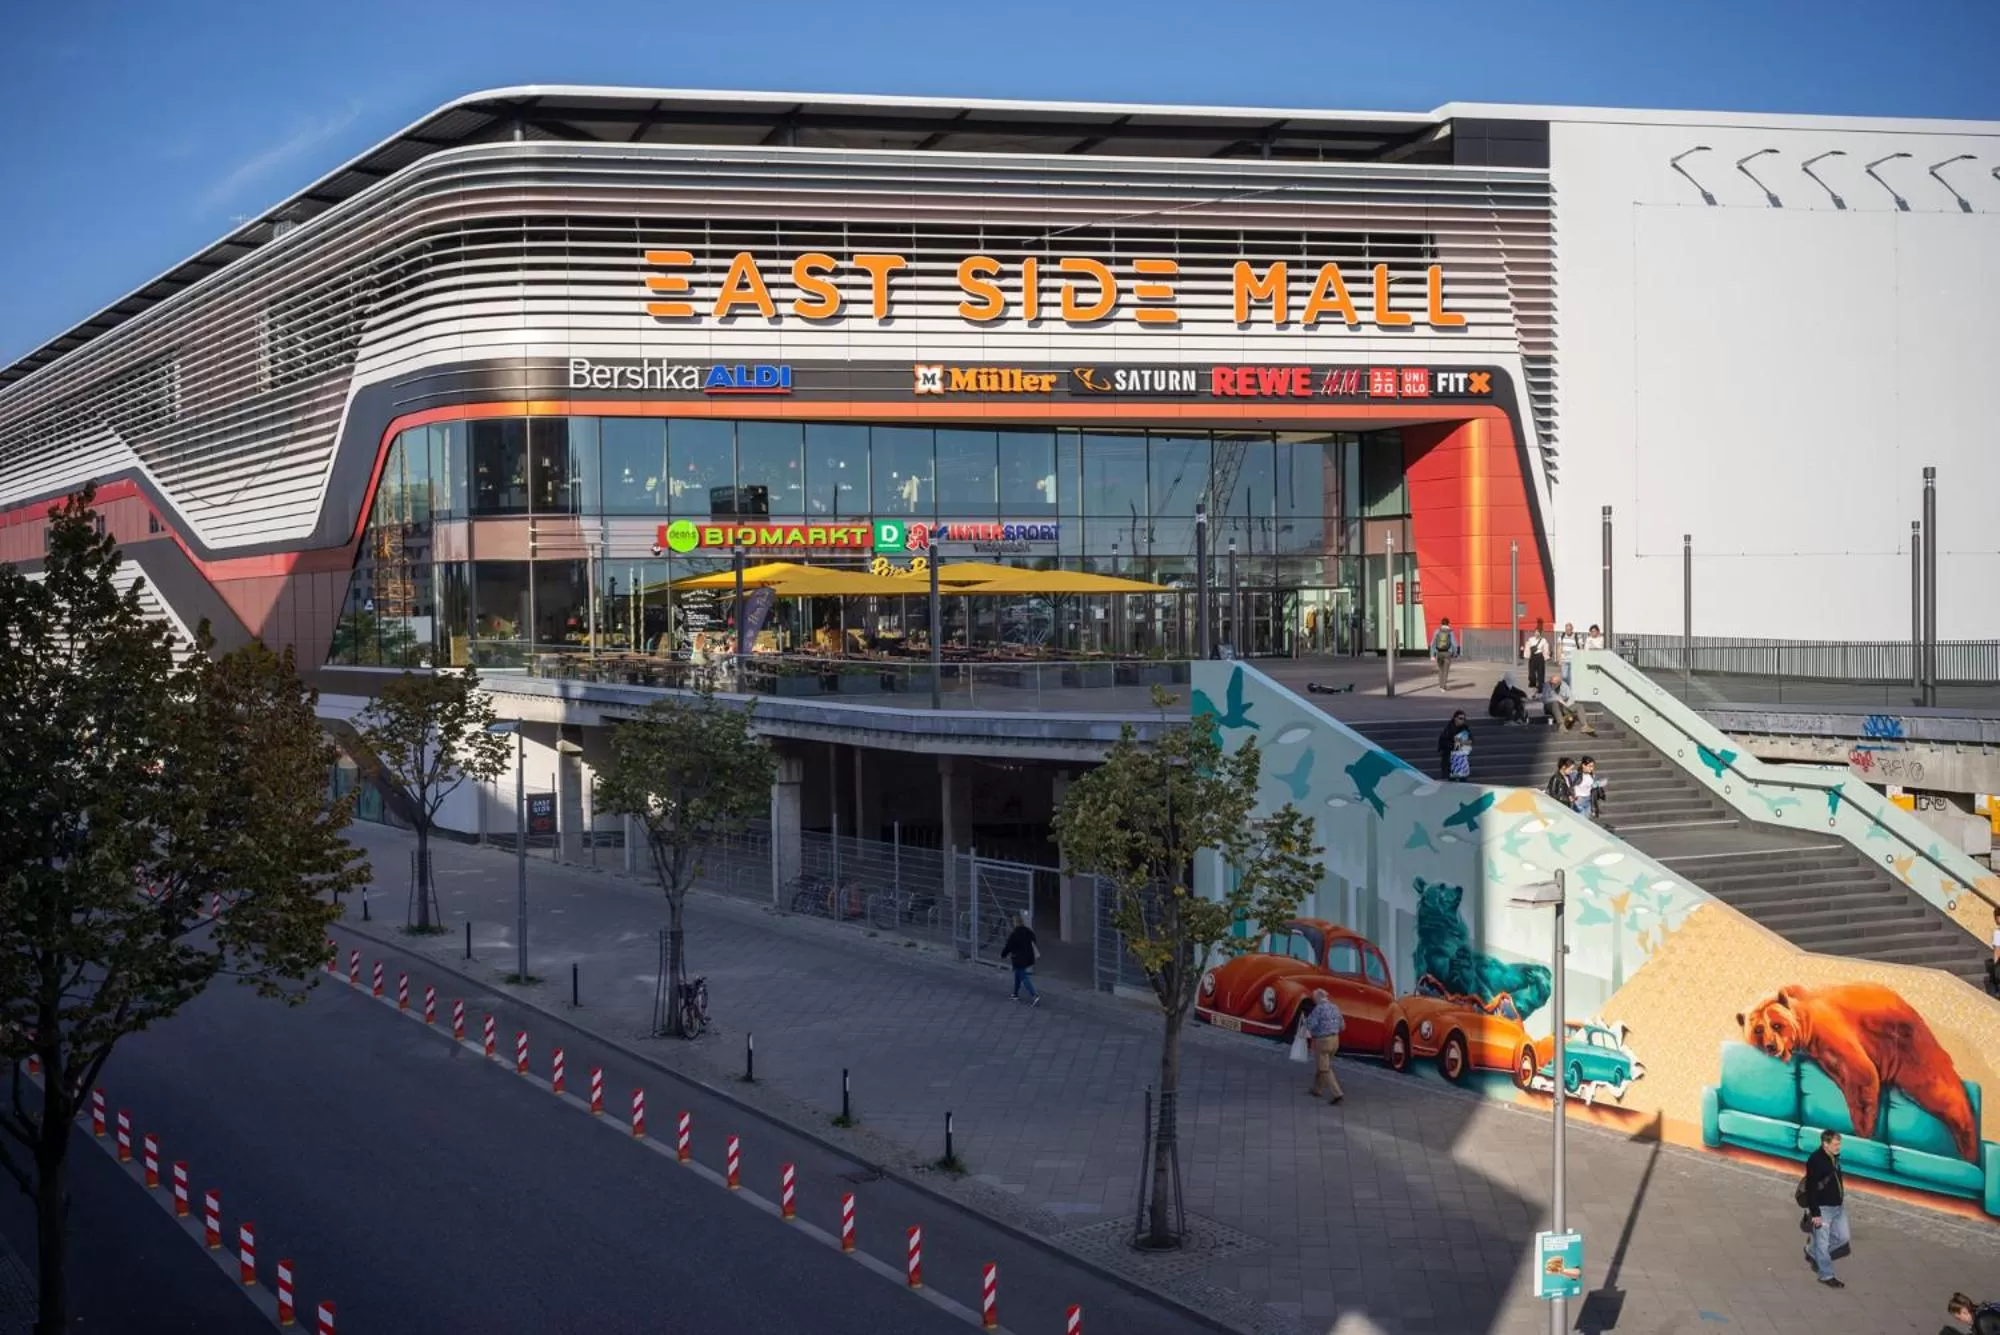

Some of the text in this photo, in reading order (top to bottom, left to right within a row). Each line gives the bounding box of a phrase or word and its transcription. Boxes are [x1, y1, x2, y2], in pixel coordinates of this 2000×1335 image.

[644, 250, 1467, 326] EAST SIDE MALL
[569, 358, 700, 390] Bershka
[703, 365, 792, 388] ALDI
[950, 367, 1057, 392] Müller
[1114, 369, 1197, 392] SATURN
[1211, 366, 1313, 397] REWE
[1404, 371, 1425, 382] UNI
[1404, 383, 1427, 394] QLO
[704, 526, 868, 546] BIOMARKT
[947, 524, 1061, 541] INTERSPORT
